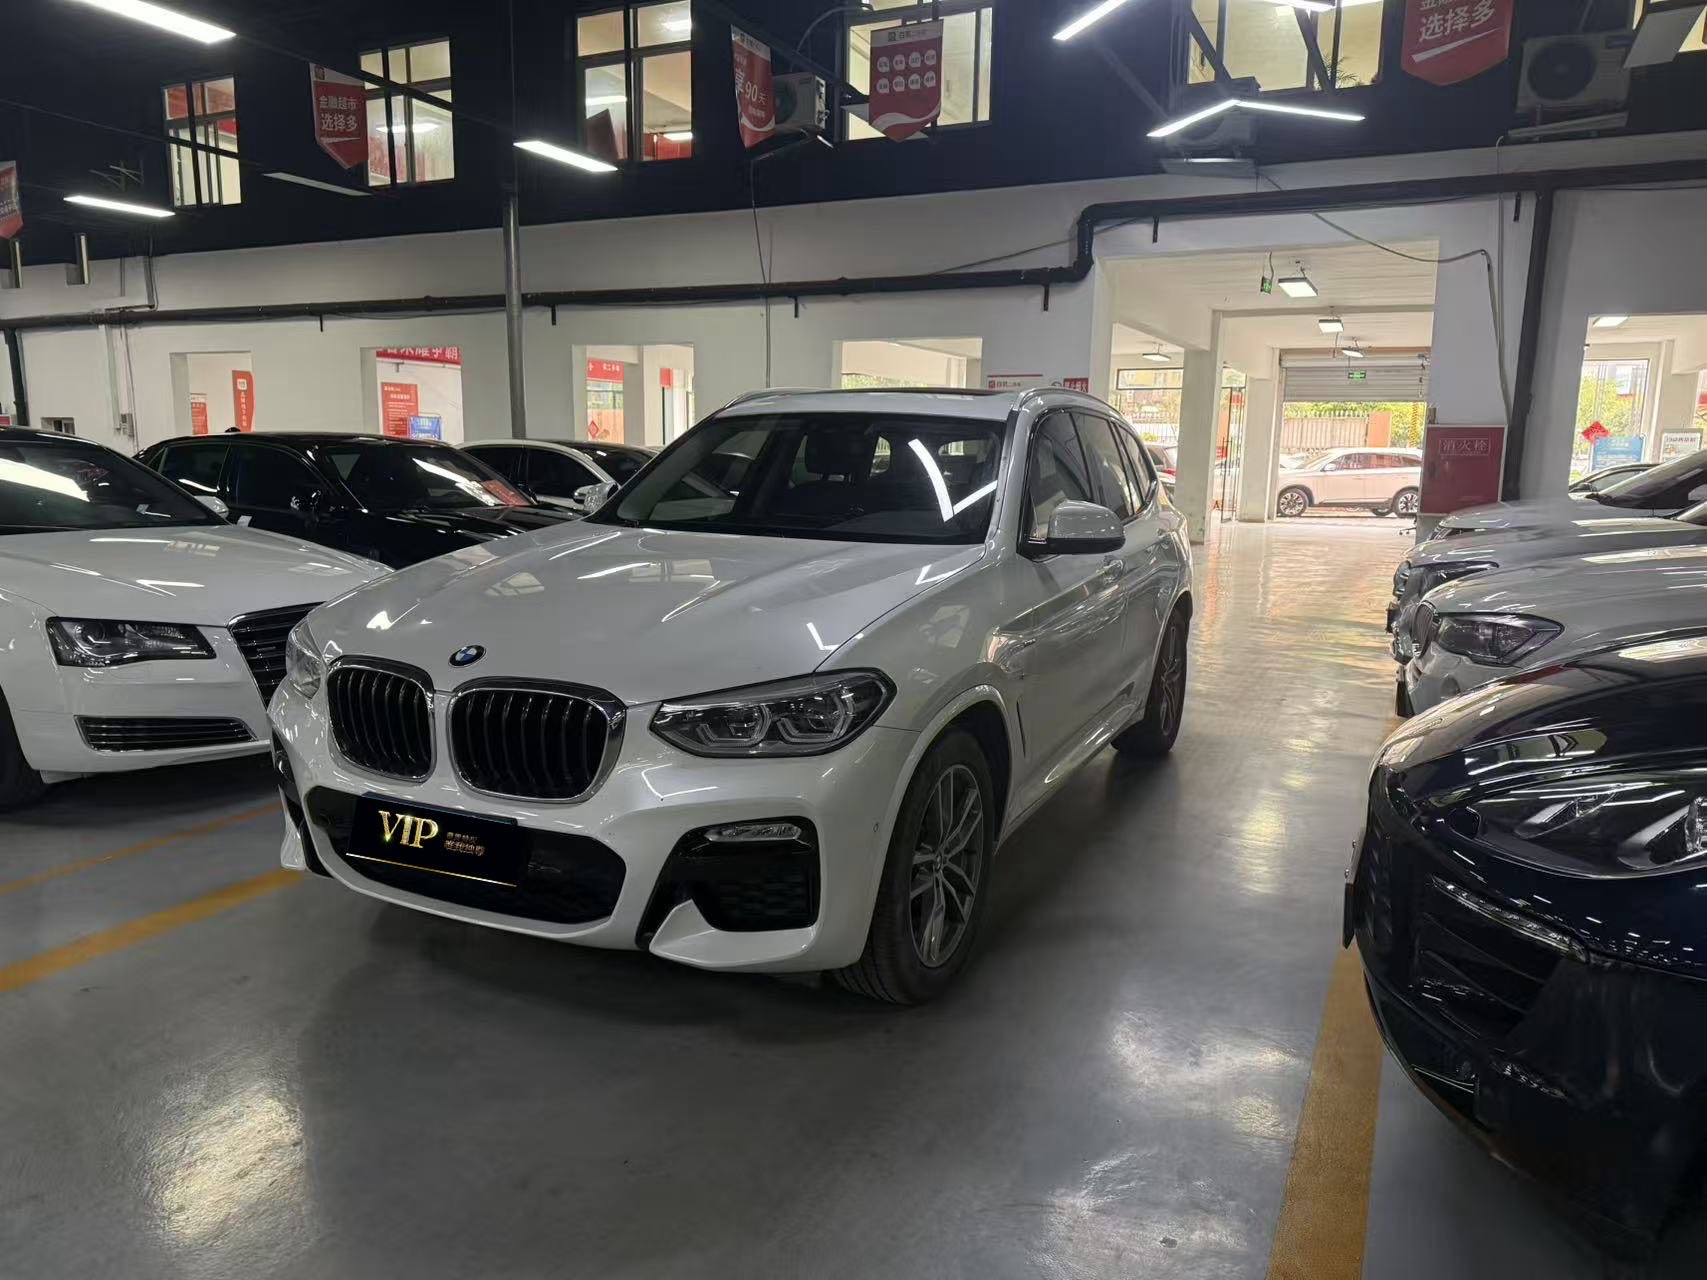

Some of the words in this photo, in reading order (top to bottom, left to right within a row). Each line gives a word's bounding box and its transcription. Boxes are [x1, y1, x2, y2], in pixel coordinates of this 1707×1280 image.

[1419, 0, 1495, 42] 选择多
[319, 95, 357, 111] 金融超市
[321, 112, 358, 132] 选择多
[378, 810, 439, 849] VIP
